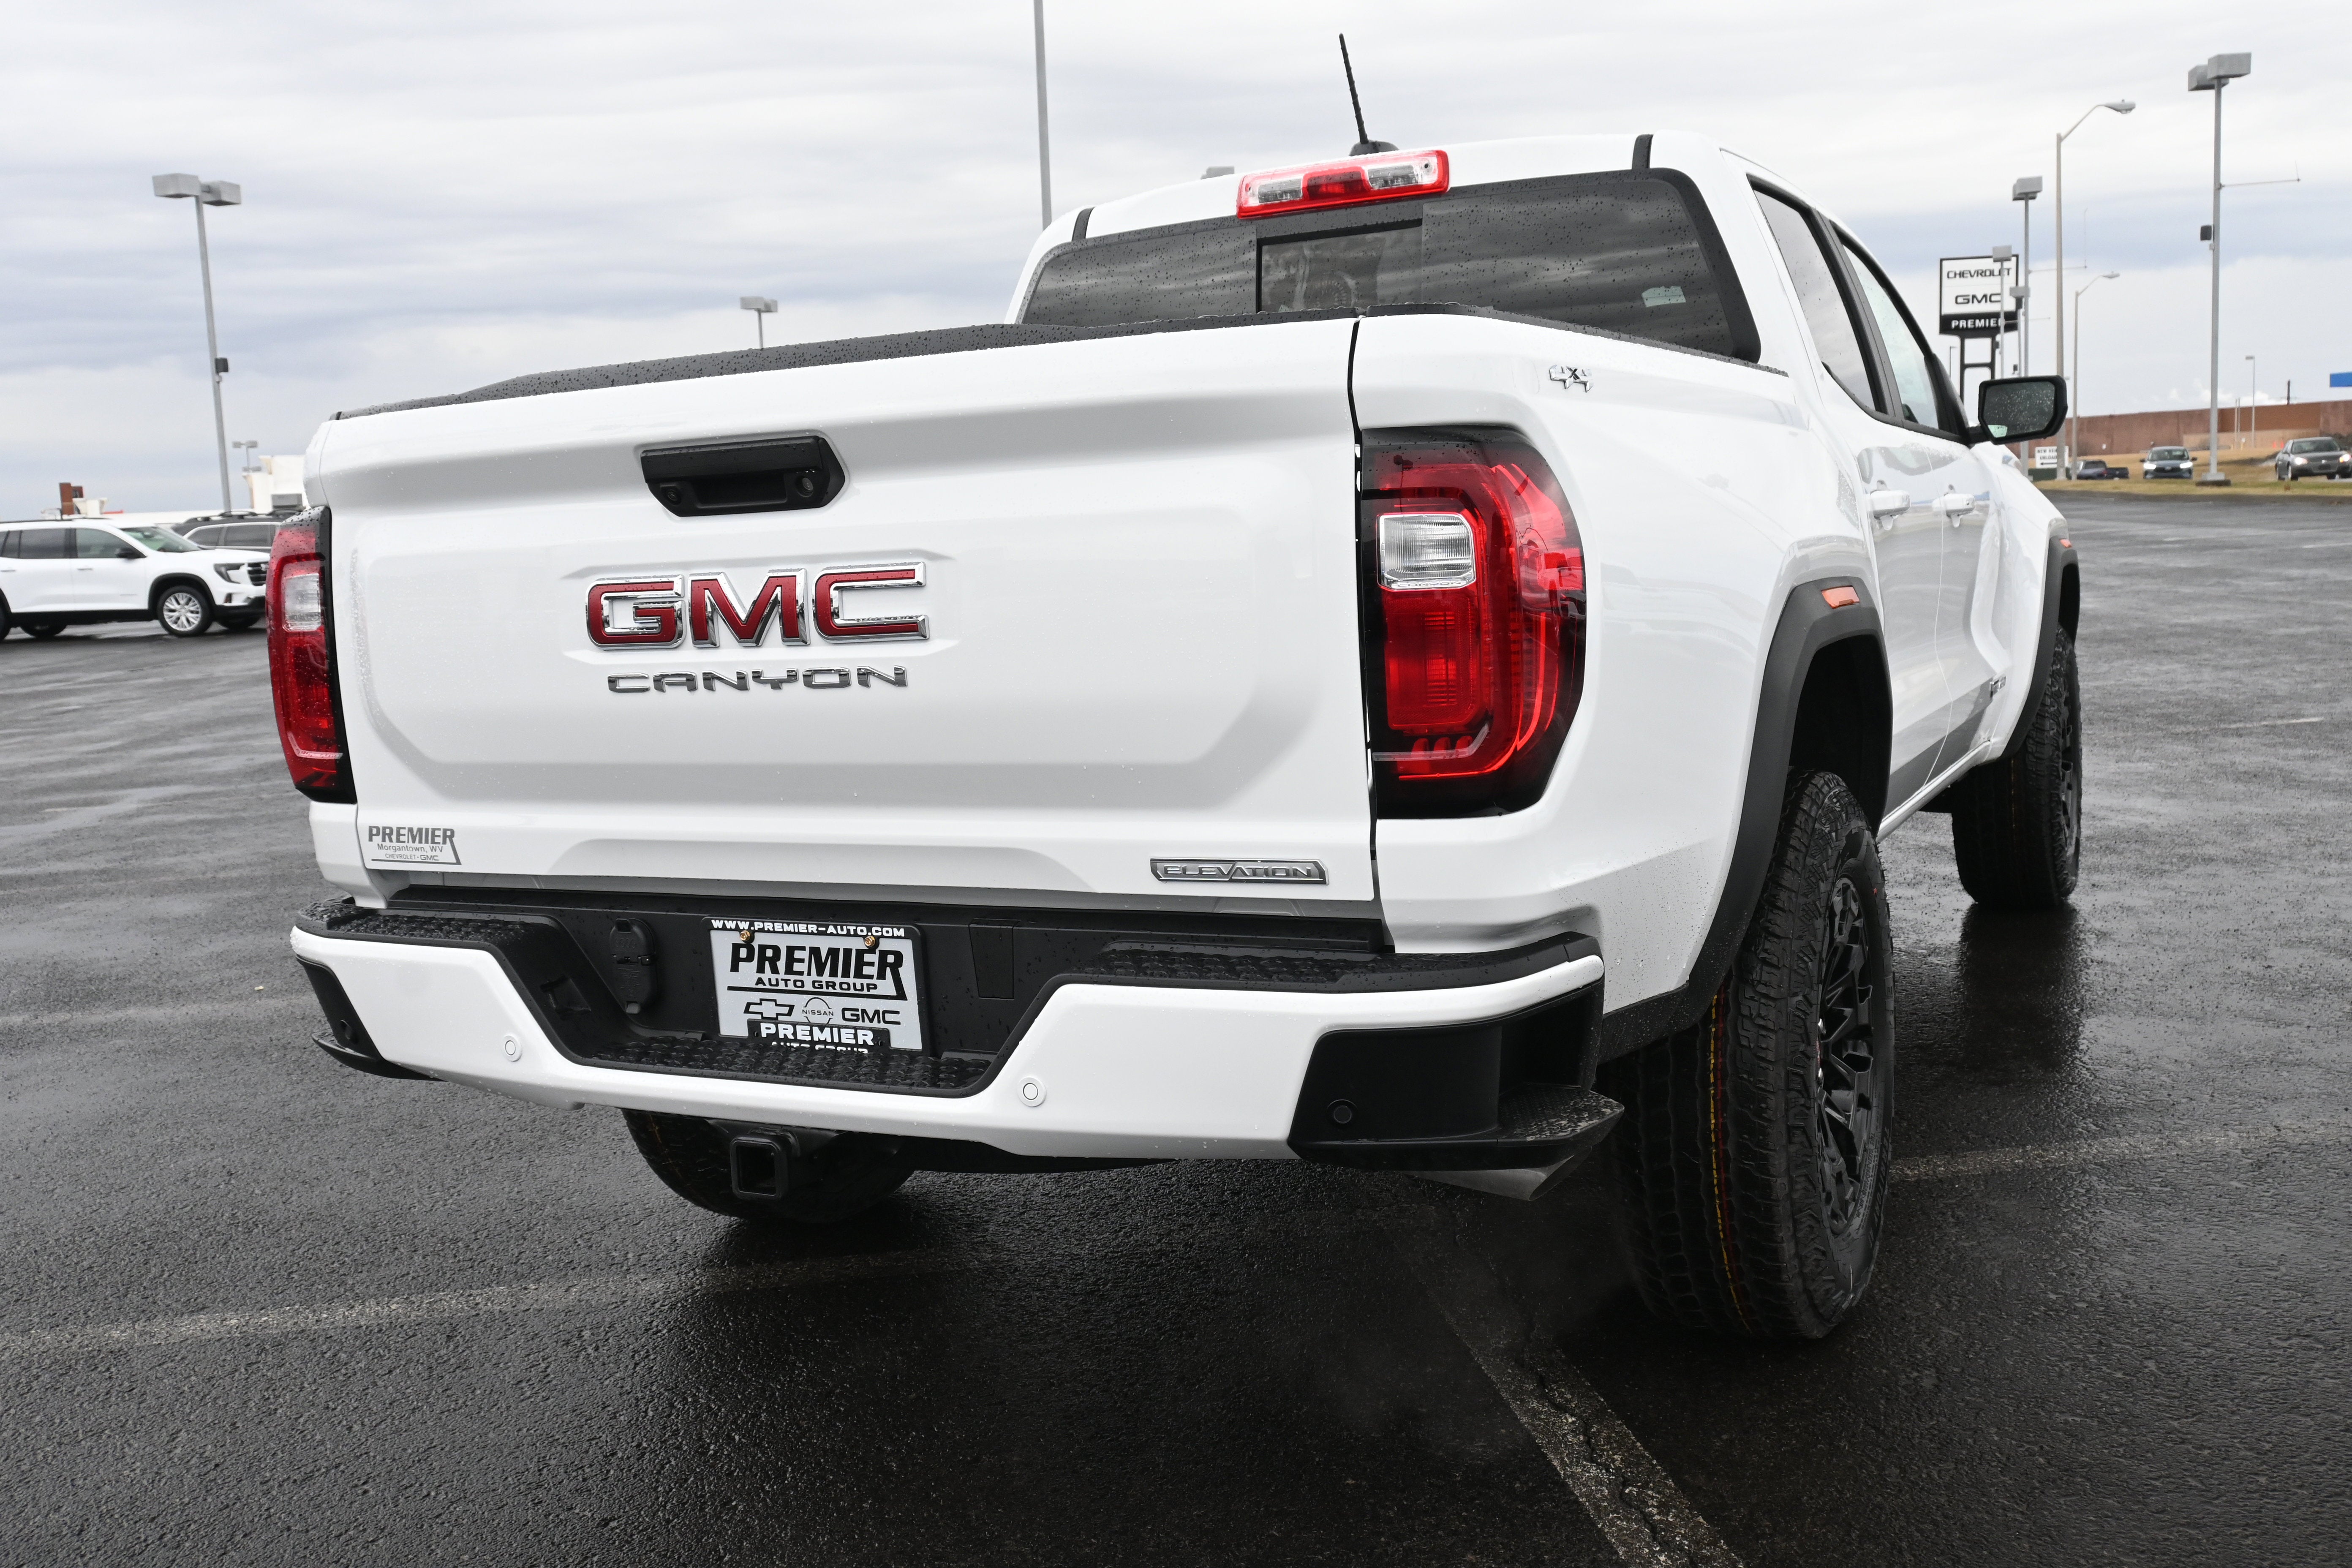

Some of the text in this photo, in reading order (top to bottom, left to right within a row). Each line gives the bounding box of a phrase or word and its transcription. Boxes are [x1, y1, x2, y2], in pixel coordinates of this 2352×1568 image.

[1955, 293, 2001, 305] GMC
[585, 562, 929, 650] GMC
[607, 665, 908, 693] CANYON
[368, 825, 455, 845] PREMIER
[377, 844, 427, 853] Morgantown,
[1164, 865, 1312, 877] ELEVATION
[711, 920, 905, 937] WWW.PREMIER-AUTO.COM
[730, 943, 905, 980] PREMIER
[754, 977, 878, 993] AUTO GROUP
[841, 1008, 901, 1025] GMC
[760, 1023, 874, 1045] PREMIER
